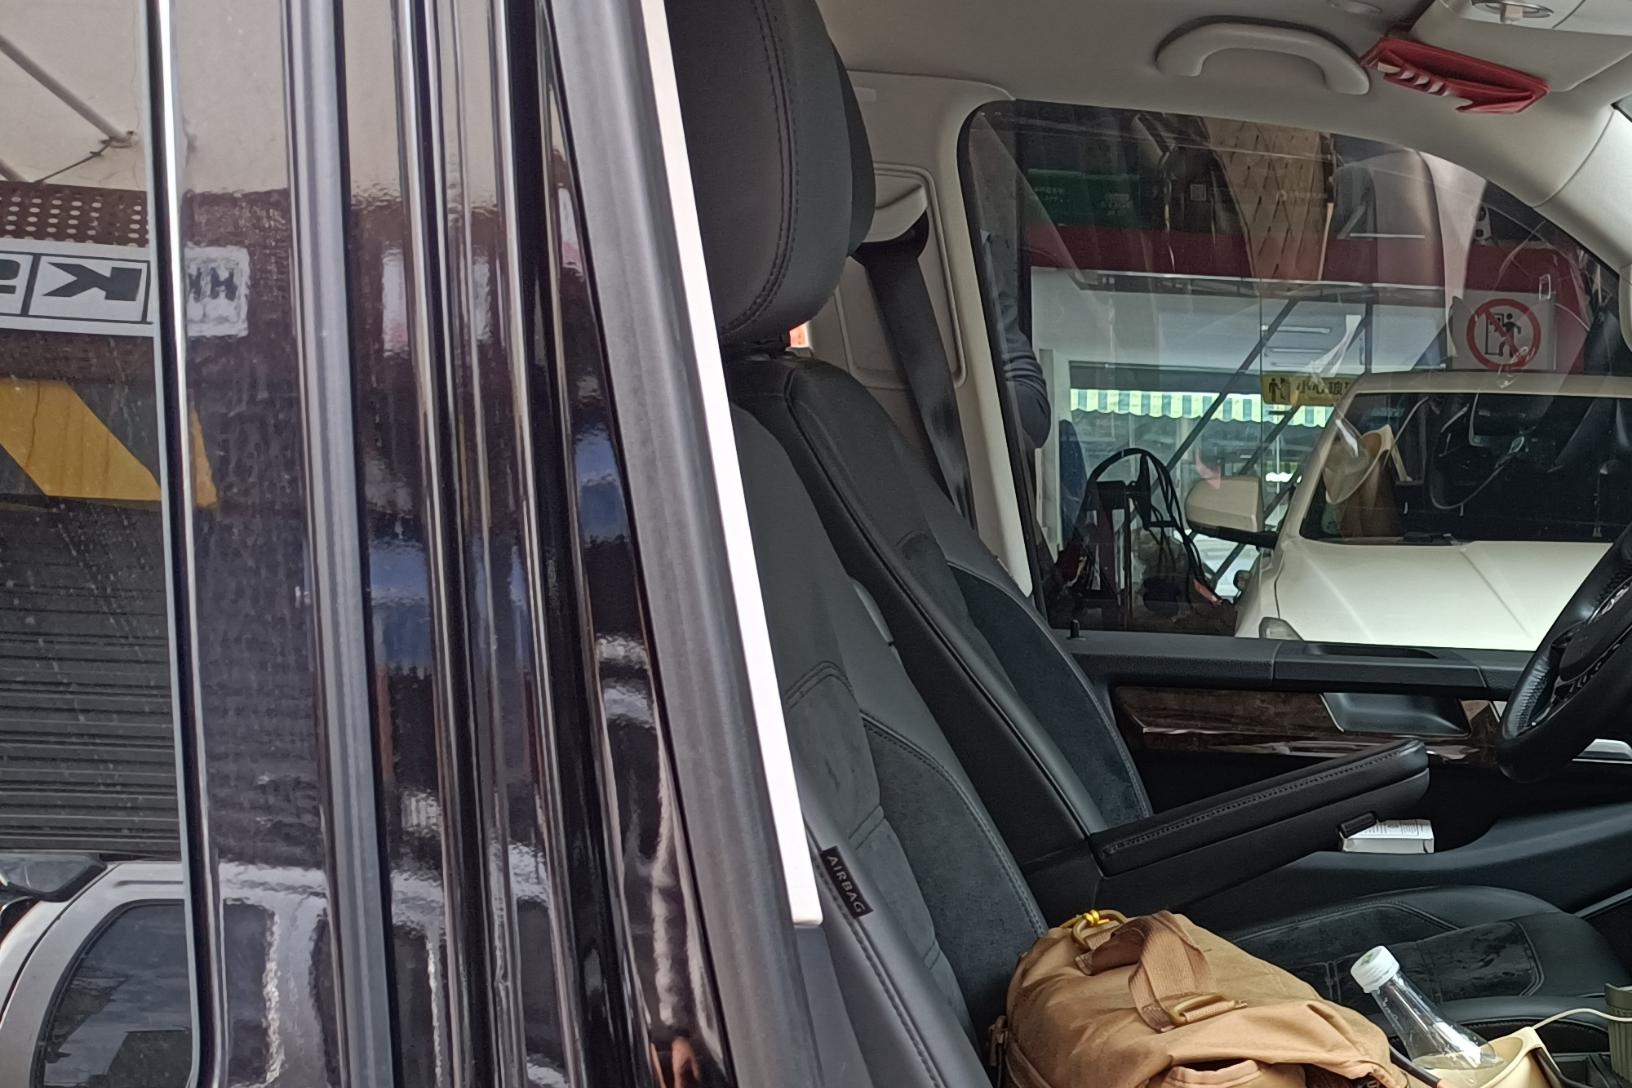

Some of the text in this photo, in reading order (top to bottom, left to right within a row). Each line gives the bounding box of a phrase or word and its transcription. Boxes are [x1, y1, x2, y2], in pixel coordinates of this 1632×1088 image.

[1296, 378, 1351, 396] 小心玻
[827, 856, 866, 912] AIRBAG
